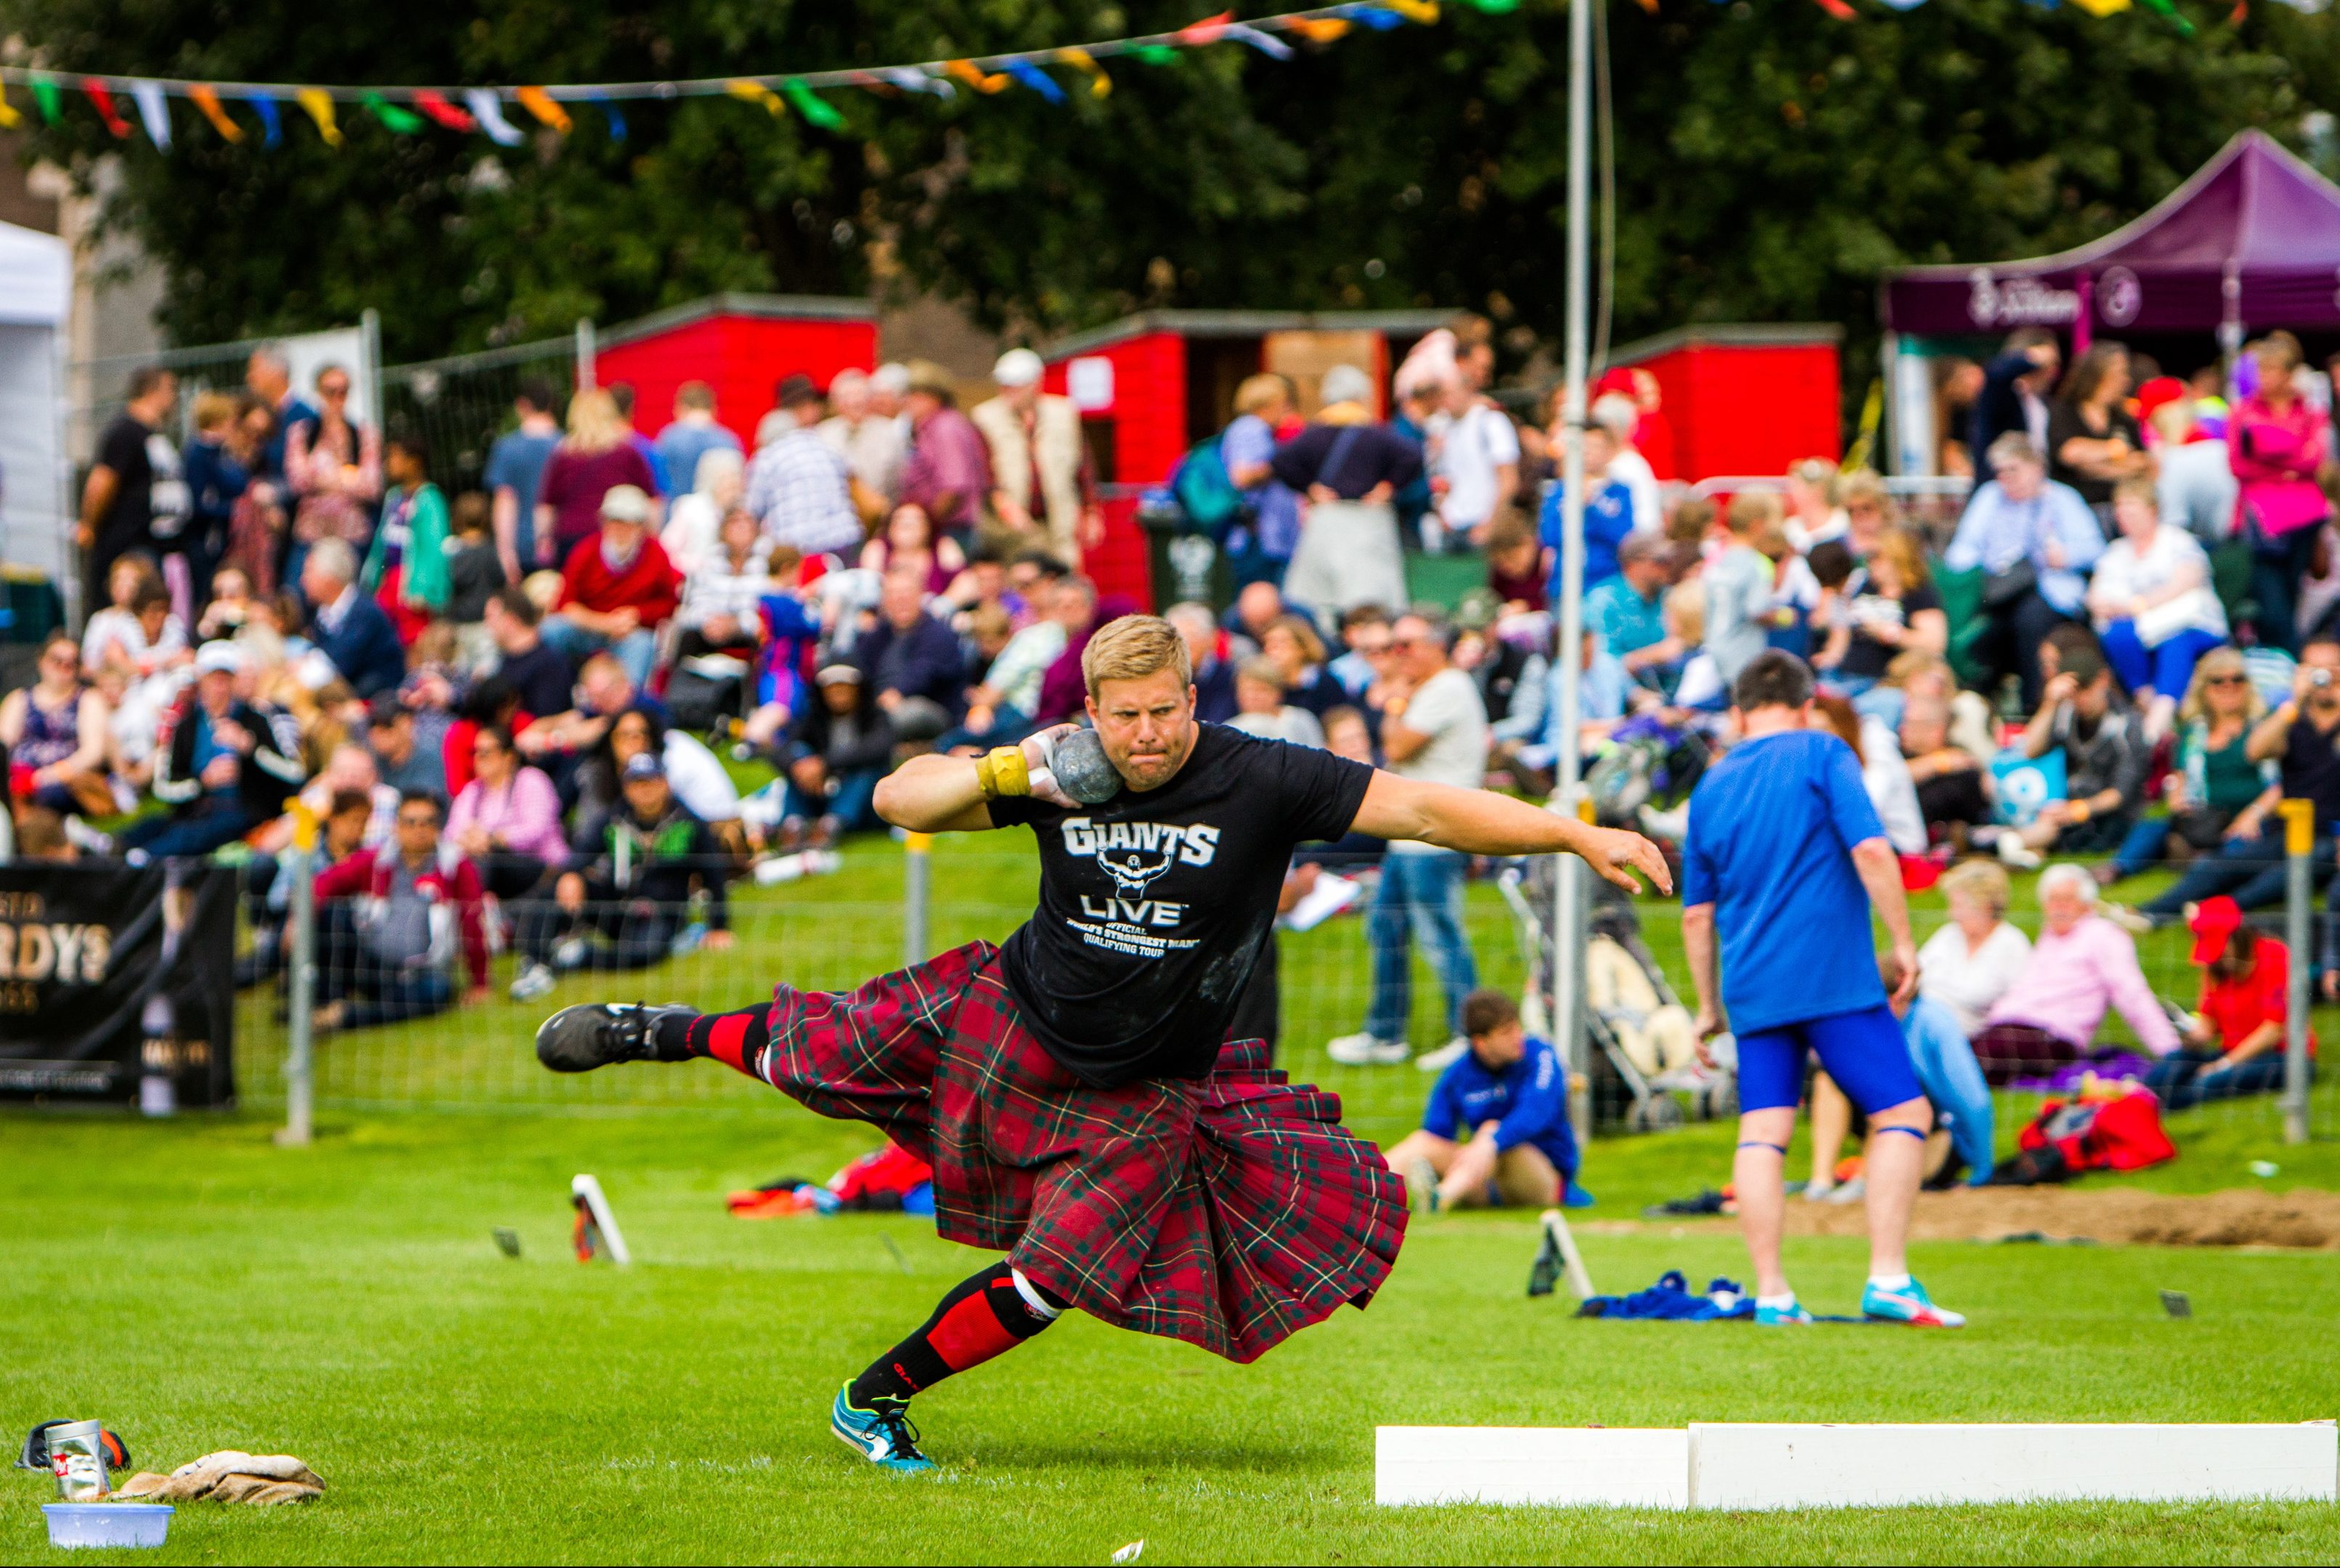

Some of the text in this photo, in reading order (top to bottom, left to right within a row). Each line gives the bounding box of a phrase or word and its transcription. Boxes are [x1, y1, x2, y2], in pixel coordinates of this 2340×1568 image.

[1061, 817, 1220, 867] GIANTS
[1104, 928, 1167, 948] STRONGEST
[1106, 921, 1147, 935] OFFICIAL
[1083, 933, 1165, 959] QUALIFYING TOUR
